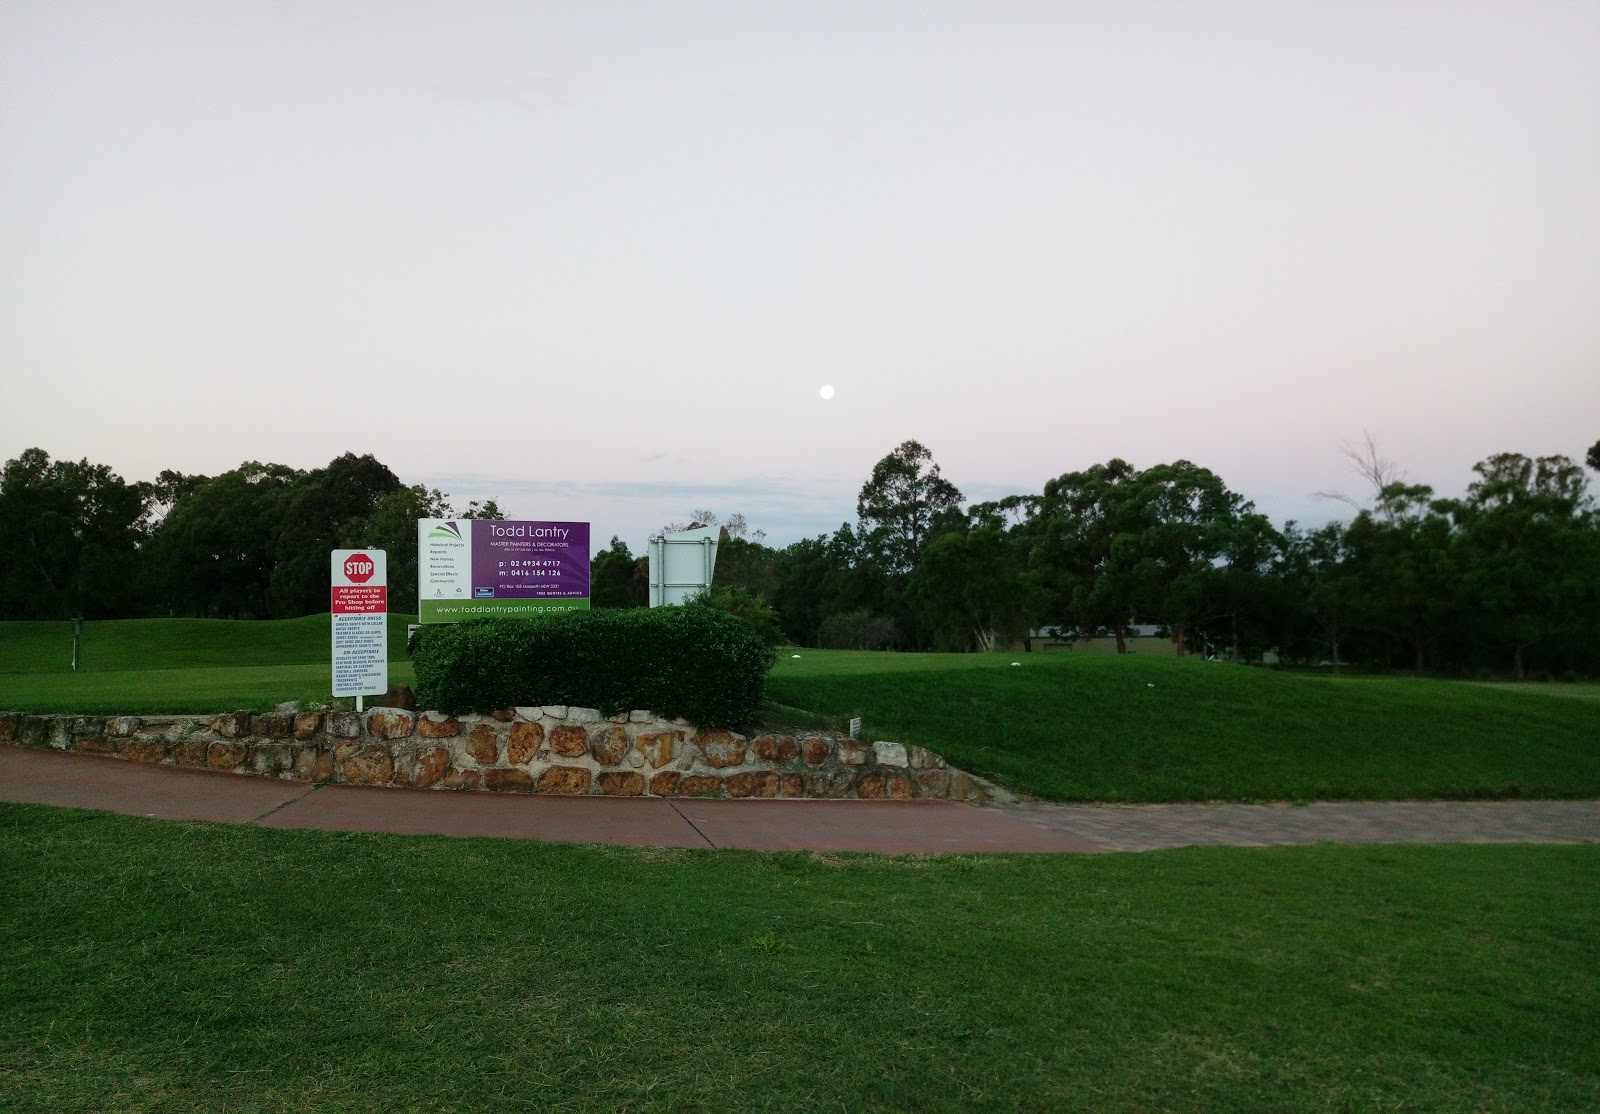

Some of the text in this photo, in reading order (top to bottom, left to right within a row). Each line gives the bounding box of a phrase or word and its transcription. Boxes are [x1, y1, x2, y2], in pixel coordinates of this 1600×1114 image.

[490, 525, 569, 540] Todd Lantry
[346, 562, 372, 575] STOP
